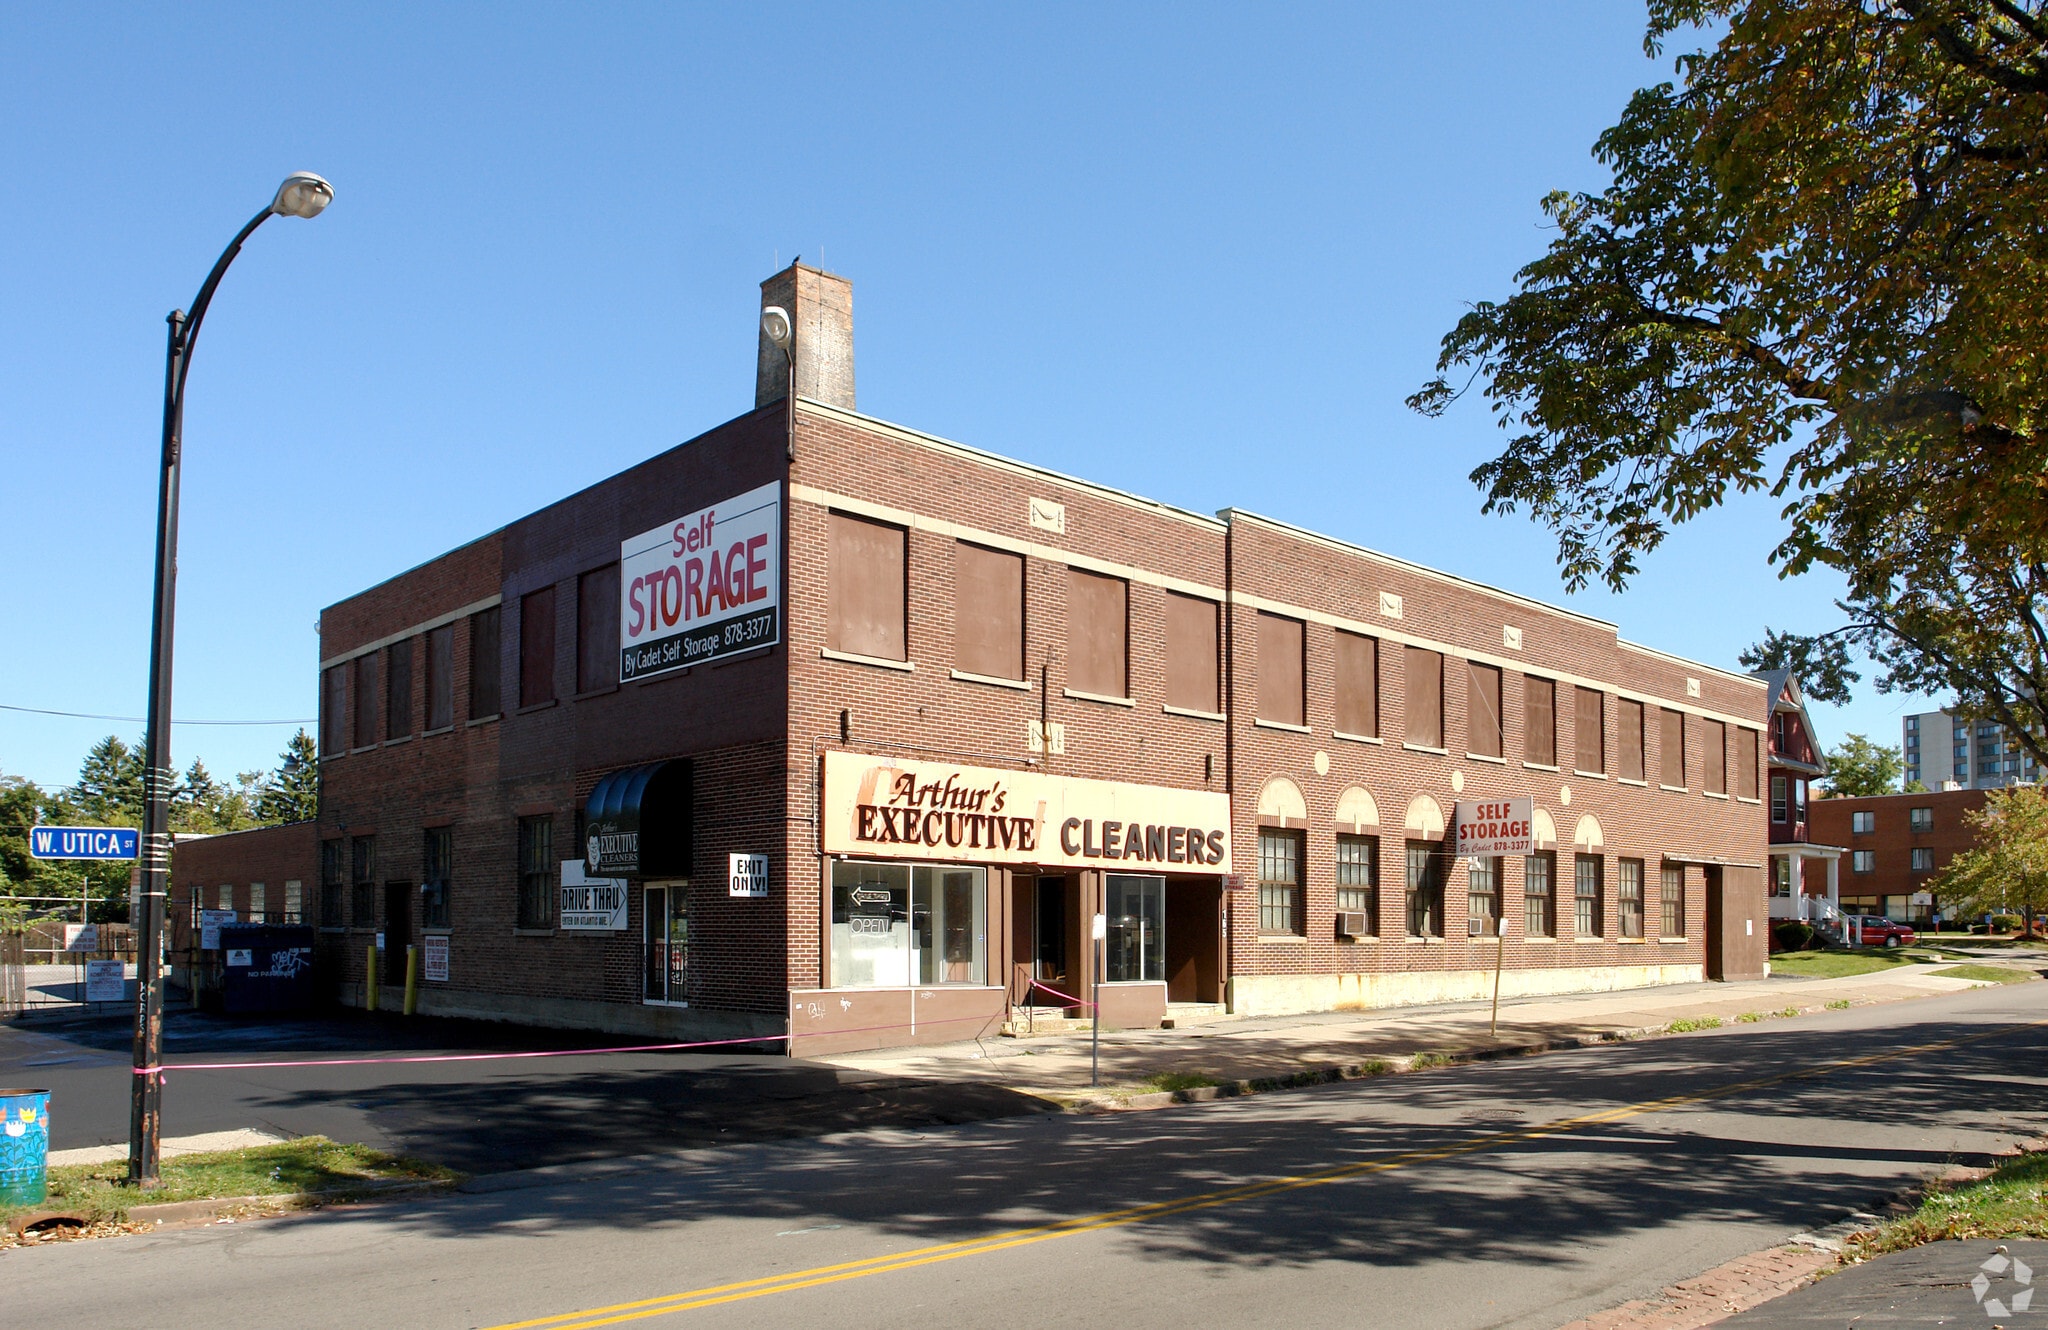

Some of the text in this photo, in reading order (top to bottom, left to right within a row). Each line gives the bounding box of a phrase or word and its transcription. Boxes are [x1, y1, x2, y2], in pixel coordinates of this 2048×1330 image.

[672, 510, 715, 558] Self
[628, 533, 768, 637] STORAGE
[625, 615, 772, 676] By Cadet Self Storage 878-3377
[888, 773, 1006, 813] Arthur's
[1477, 803, 1511, 820] SELF
[856, 804, 1226, 866] EXECUTIVE CLEANERS
[1460, 821, 1529, 840] STORAGE
[36, 832, 134, 854] W. UTICA ST
[601, 833, 638, 853] EXECUTIVE
[1460, 841, 1529, 853] By Cadet 878-3377
[601, 853, 638, 862] CLEANERS
[737, 859, 763, 874] EXIT
[732, 876, 766, 891] ONLY!
[562, 887, 619, 910] DRIVE THRU
[851, 918, 889, 933] OPEN
